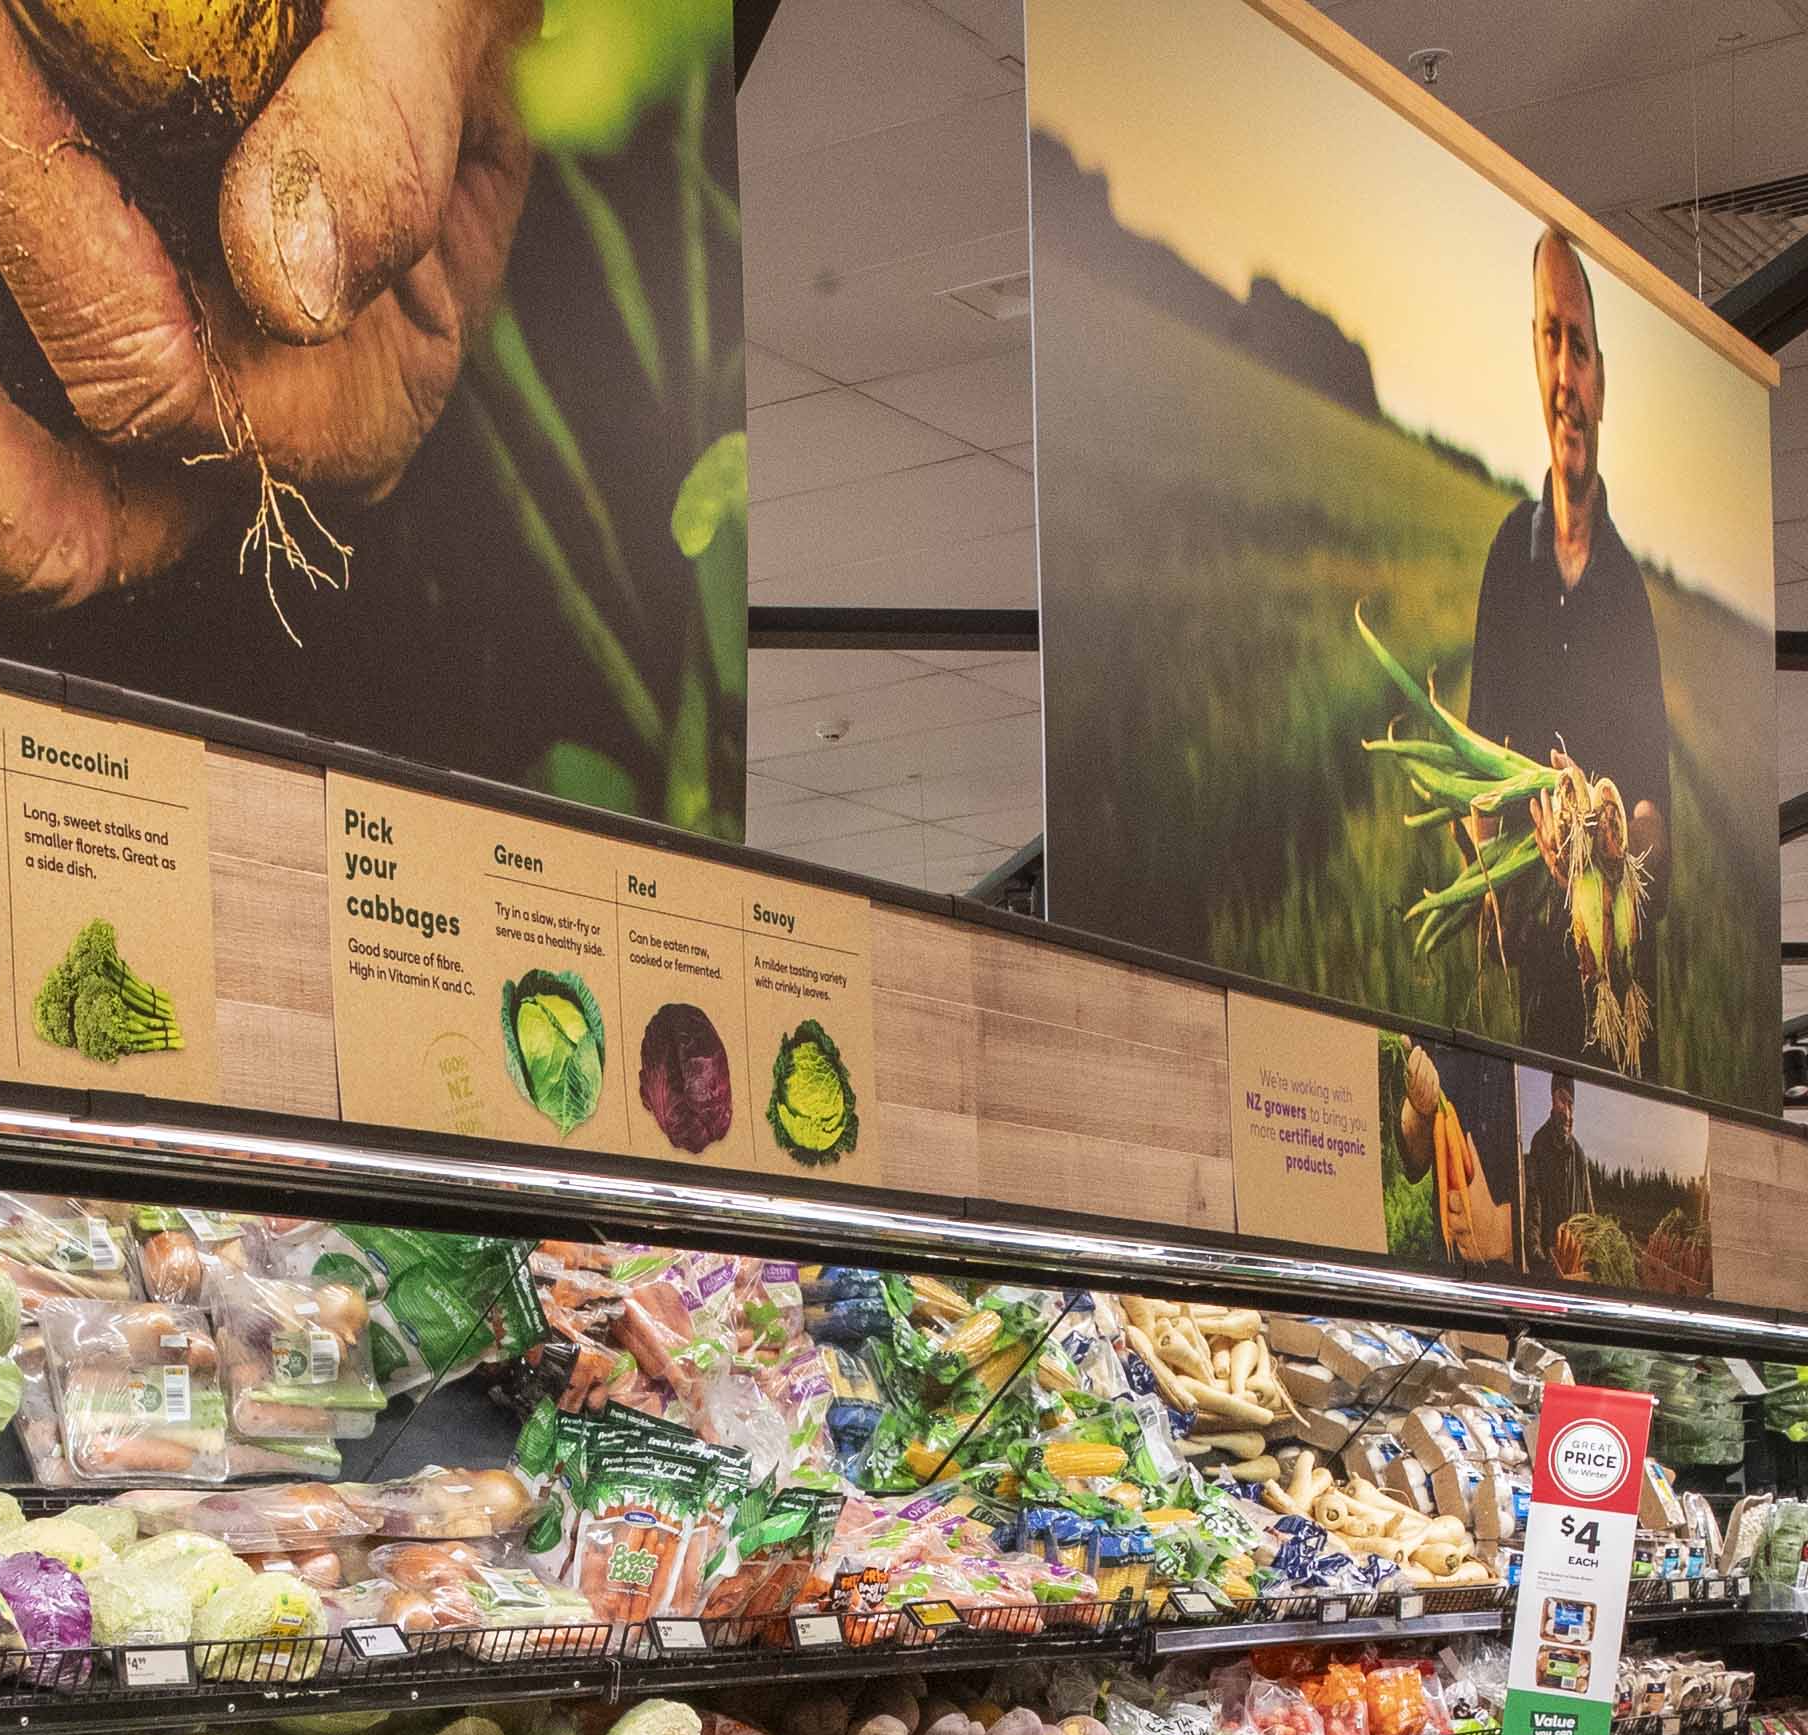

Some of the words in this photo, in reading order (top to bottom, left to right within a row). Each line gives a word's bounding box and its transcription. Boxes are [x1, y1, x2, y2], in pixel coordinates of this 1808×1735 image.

[21, 735, 128, 780] Broccolini
[24, 803, 60, 828] Long,
[63, 816, 101, 832] sweet
[105, 822, 141, 840] stalks
[144, 832, 168, 845] and
[345, 808, 393, 845] Pick
[25, 832, 73, 850] smaller
[76, 838, 119, 860] florets.
[122, 847, 158, 867] Great
[161, 858, 176, 870] as
[494, 845, 543, 873] Green
[26, 856, 34, 867] a
[37, 855, 63, 873] side
[67, 861, 96, 879] dish.
[345, 852, 397, 880] your
[628, 875, 656, 898] Red
[347, 894, 460, 938] cabbages
[495, 902, 511, 920] Try
[558, 917, 590, 937] stir-fry
[753, 903, 795, 933] Savoy
[495, 926, 522, 940] serve
[524, 931, 535, 943] as
[545, 933, 582, 956] healthy
[628, 929, 649, 946] Can
[650, 933, 662, 949] be
[663, 939, 690, 954] eaten
[348, 938, 380, 957] Good
[383, 948, 420, 964] source
[423, 953, 435, 966] of
[436, 954, 464, 973] fibre.
[629, 952, 663, 968] cooked
[349, 961, 374, 980] High
[377, 970, 386, 979] in
[388, 968, 430, 987] Vitamin
[442, 981, 461, 993] and
[463, 981, 476, 996] C.
[1246, 1092, 1262, 1111] NZ
[1264, 1100, 1306, 1120] growers
[1279, 1129, 1324, 1148] certified
[1327, 1138, 1365, 1157] organic
[1286, 1156, 1336, 1175] products.
[1564, 1450, 1618, 1469] PRICE
[1571, 1440, 1613, 1453] GREAT
[1560, 1513, 1601, 1555] $4
[1568, 1555, 1599, 1569] EACH
[1533, 1713, 1576, 1729] Value
